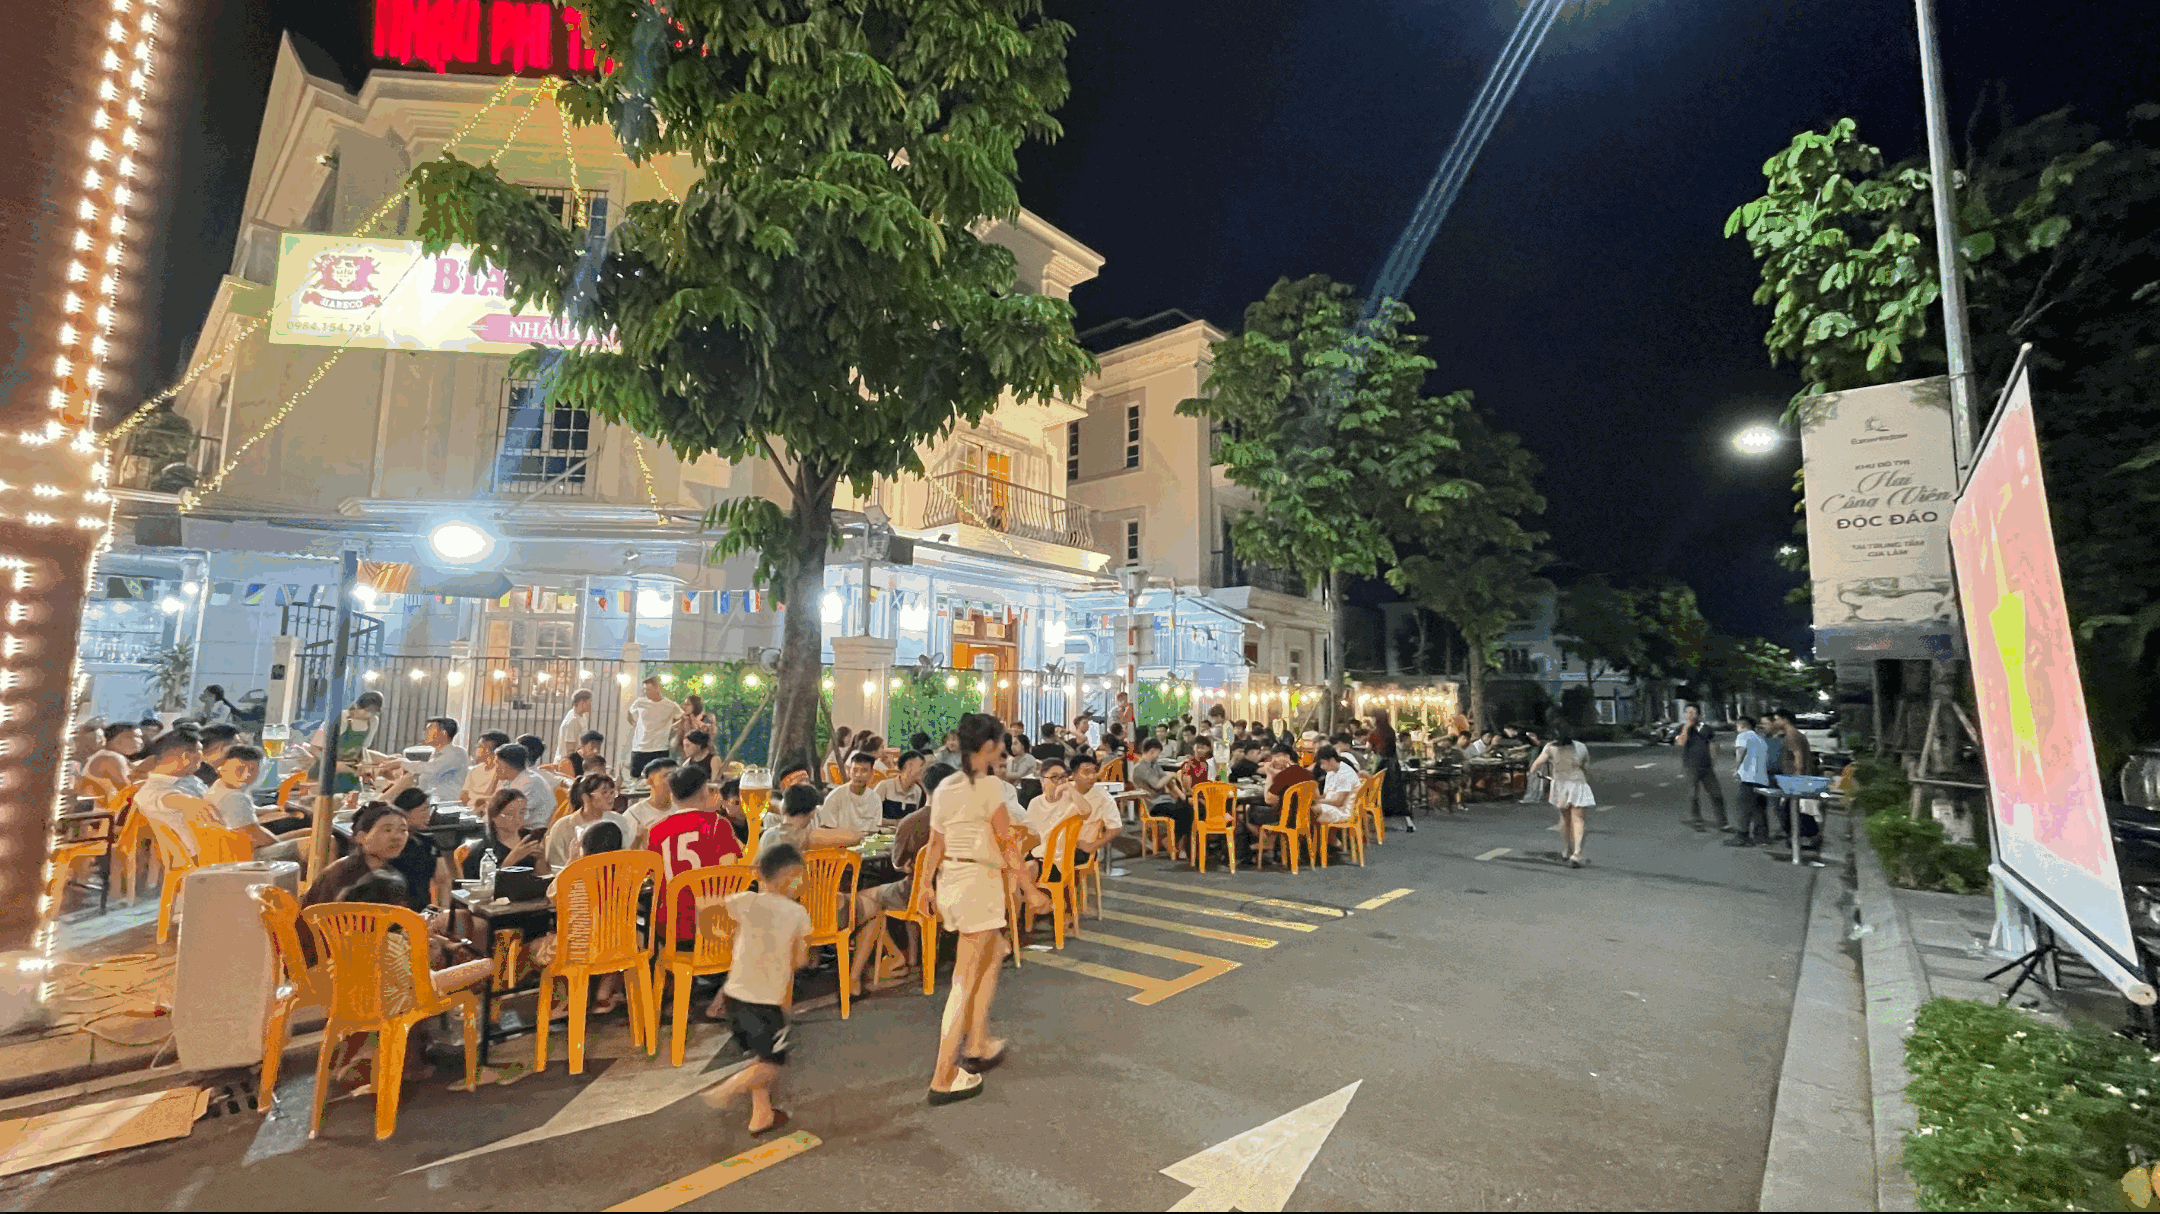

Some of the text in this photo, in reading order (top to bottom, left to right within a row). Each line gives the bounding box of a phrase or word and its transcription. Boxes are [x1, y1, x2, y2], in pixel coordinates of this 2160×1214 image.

[1836, 509, 1939, 531] ĐỘC ĐÁO
[661, 831, 702, 885] 15
